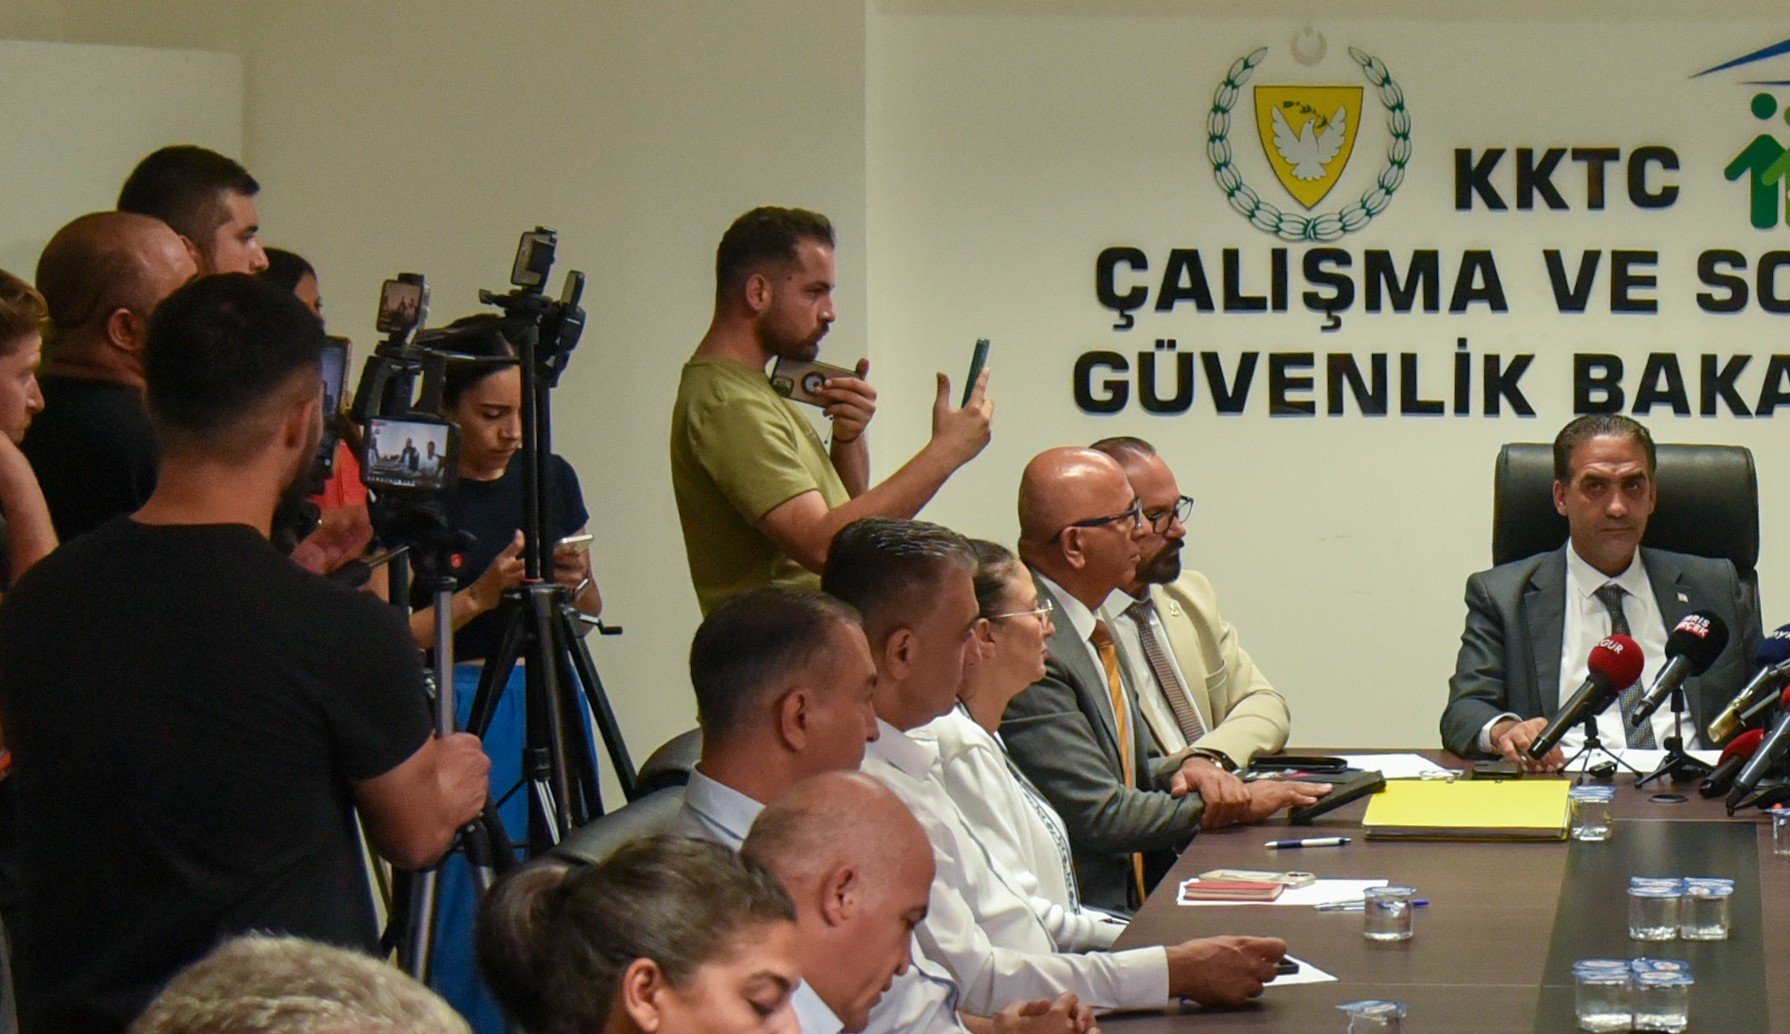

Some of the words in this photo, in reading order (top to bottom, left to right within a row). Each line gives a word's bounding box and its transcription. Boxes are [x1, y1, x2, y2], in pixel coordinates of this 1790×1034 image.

[1455, 146, 1680, 210] KKTC
[1096, 246, 1508, 331] ÇALIŞMA
[1543, 249, 1658, 313] VE
[1074, 337, 1536, 416] GÜVENLİK
